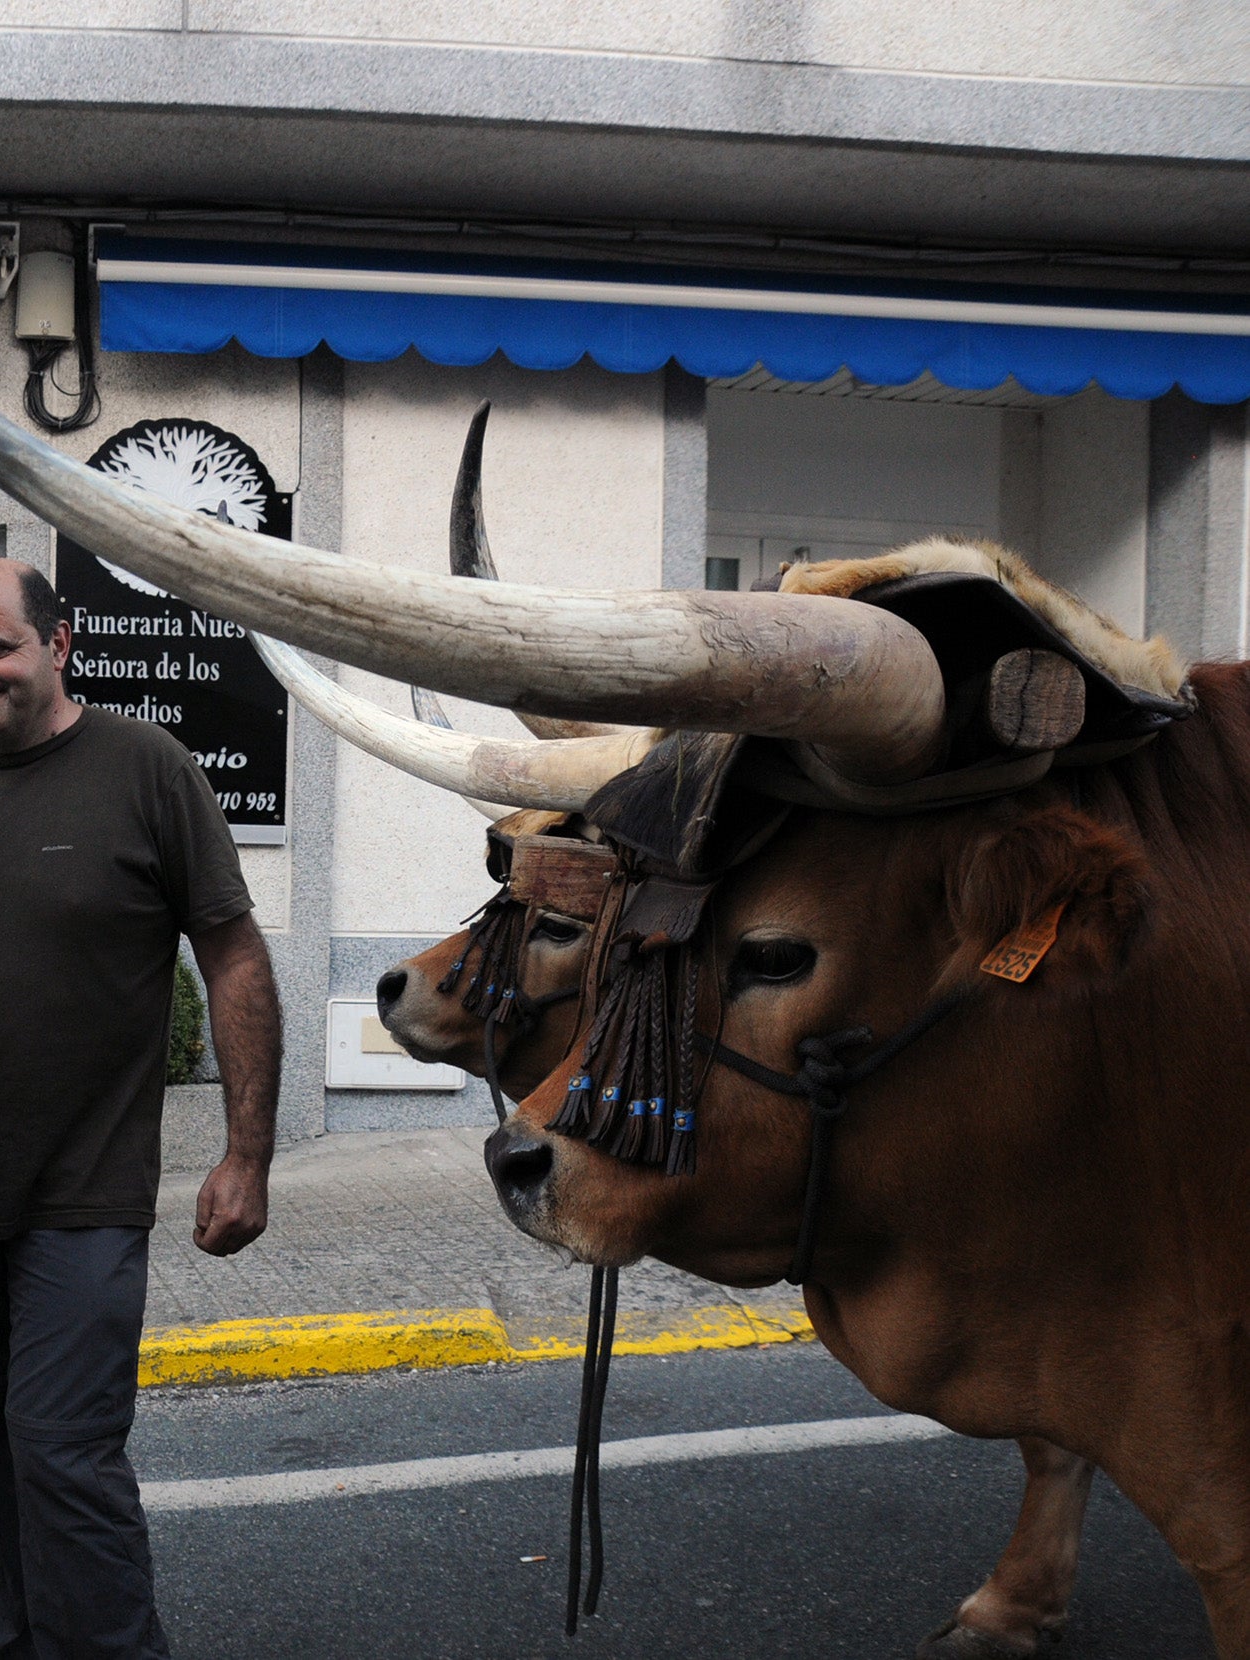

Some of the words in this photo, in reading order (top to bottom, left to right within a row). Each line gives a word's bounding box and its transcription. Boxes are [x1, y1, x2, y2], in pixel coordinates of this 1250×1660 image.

[72, 606, 184, 636] Funeraria
[189, 610, 246, 639] Nues
[71, 650, 149, 681] Señora
[155, 652, 181, 680] de
[187, 653, 221, 682] los
[246, 791, 277, 812] 952
[983, 946, 1039, 978] 1525
